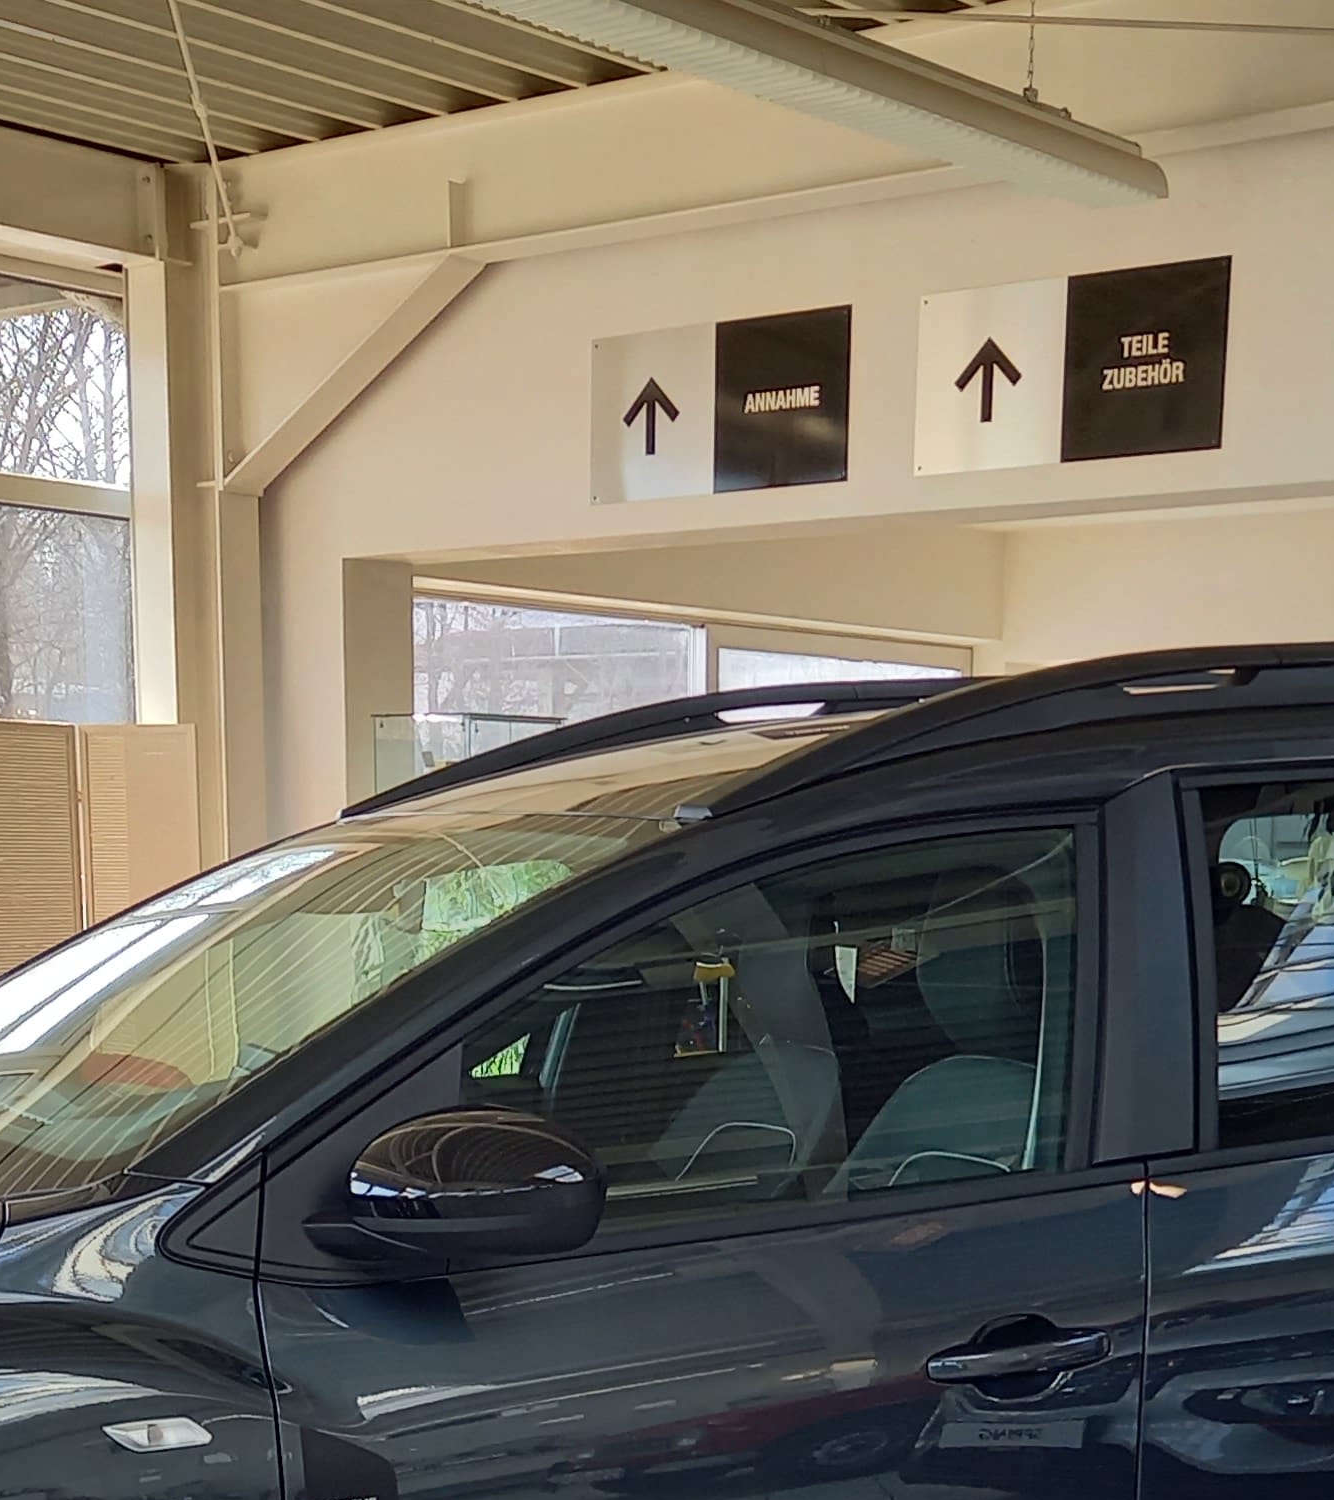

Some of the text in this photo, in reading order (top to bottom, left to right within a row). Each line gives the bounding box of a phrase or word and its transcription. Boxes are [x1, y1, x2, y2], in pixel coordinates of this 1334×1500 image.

[1120, 332, 1170, 358] TEILE
[1102, 358, 1185, 391] ZUBEHÖR
[744, 385, 820, 414] ANNAHME
